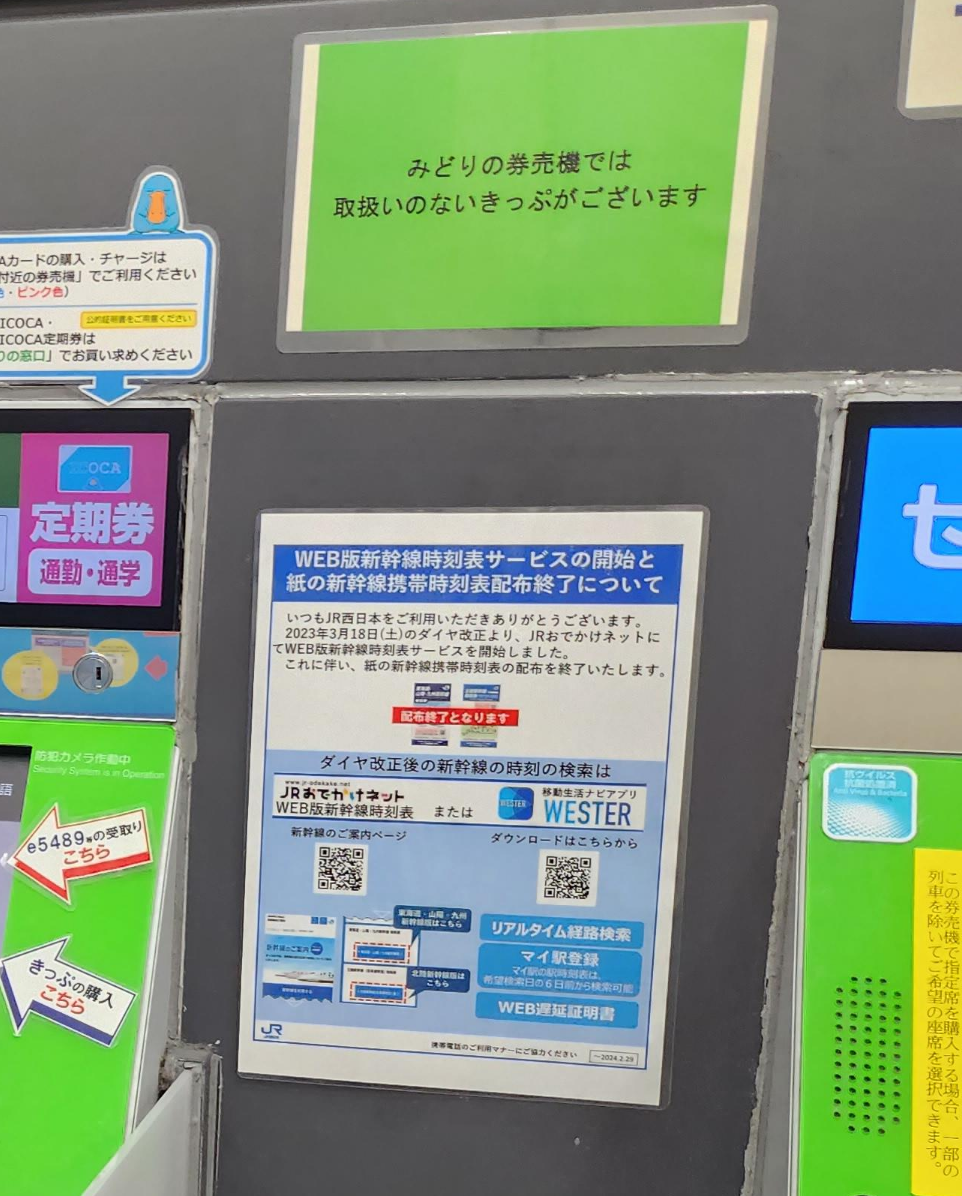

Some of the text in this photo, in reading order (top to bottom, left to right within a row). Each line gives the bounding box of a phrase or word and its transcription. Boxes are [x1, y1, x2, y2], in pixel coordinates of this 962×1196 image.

[407, 149, 632, 180] みどりの券売機では
[333, 182, 707, 219] 取扱いのないきっぷがございます
[29, 501, 155, 545] 定期券
[295, 549, 655, 571] WEB版新幹線時刻表サービスの開始と
[39, 558, 141, 588] 通勤・通学
[286, 573, 664, 595] 紙の新幹線携帯時刻表配布終了について
[286, 612, 643, 629] いつもJR西日本をご利用いただきありがとうございます。
[400, 710, 510, 724] 配布終了となります
[320, 755, 612, 778] ダイヤ改正後の新幹線の時刻の検索は
[276, 801, 474, 820] WEB版新幹線時刻表 または
[544, 799, 631, 826] WESTER
[291, 826, 407, 841] 新幹線のご案内ページ
[491, 832, 639, 849] ダウンロードはこちらから
[63, 844, 110, 866] こちら
[491, 921, 632, 942] リアルタイム経路検索
[521, 950, 600, 967] マイ駅登録
[28, 958, 116, 1010] きっぷの購入
[40, 984, 85, 1016] こちら
[498, 1000, 616, 1022] WEB遅延証明書
